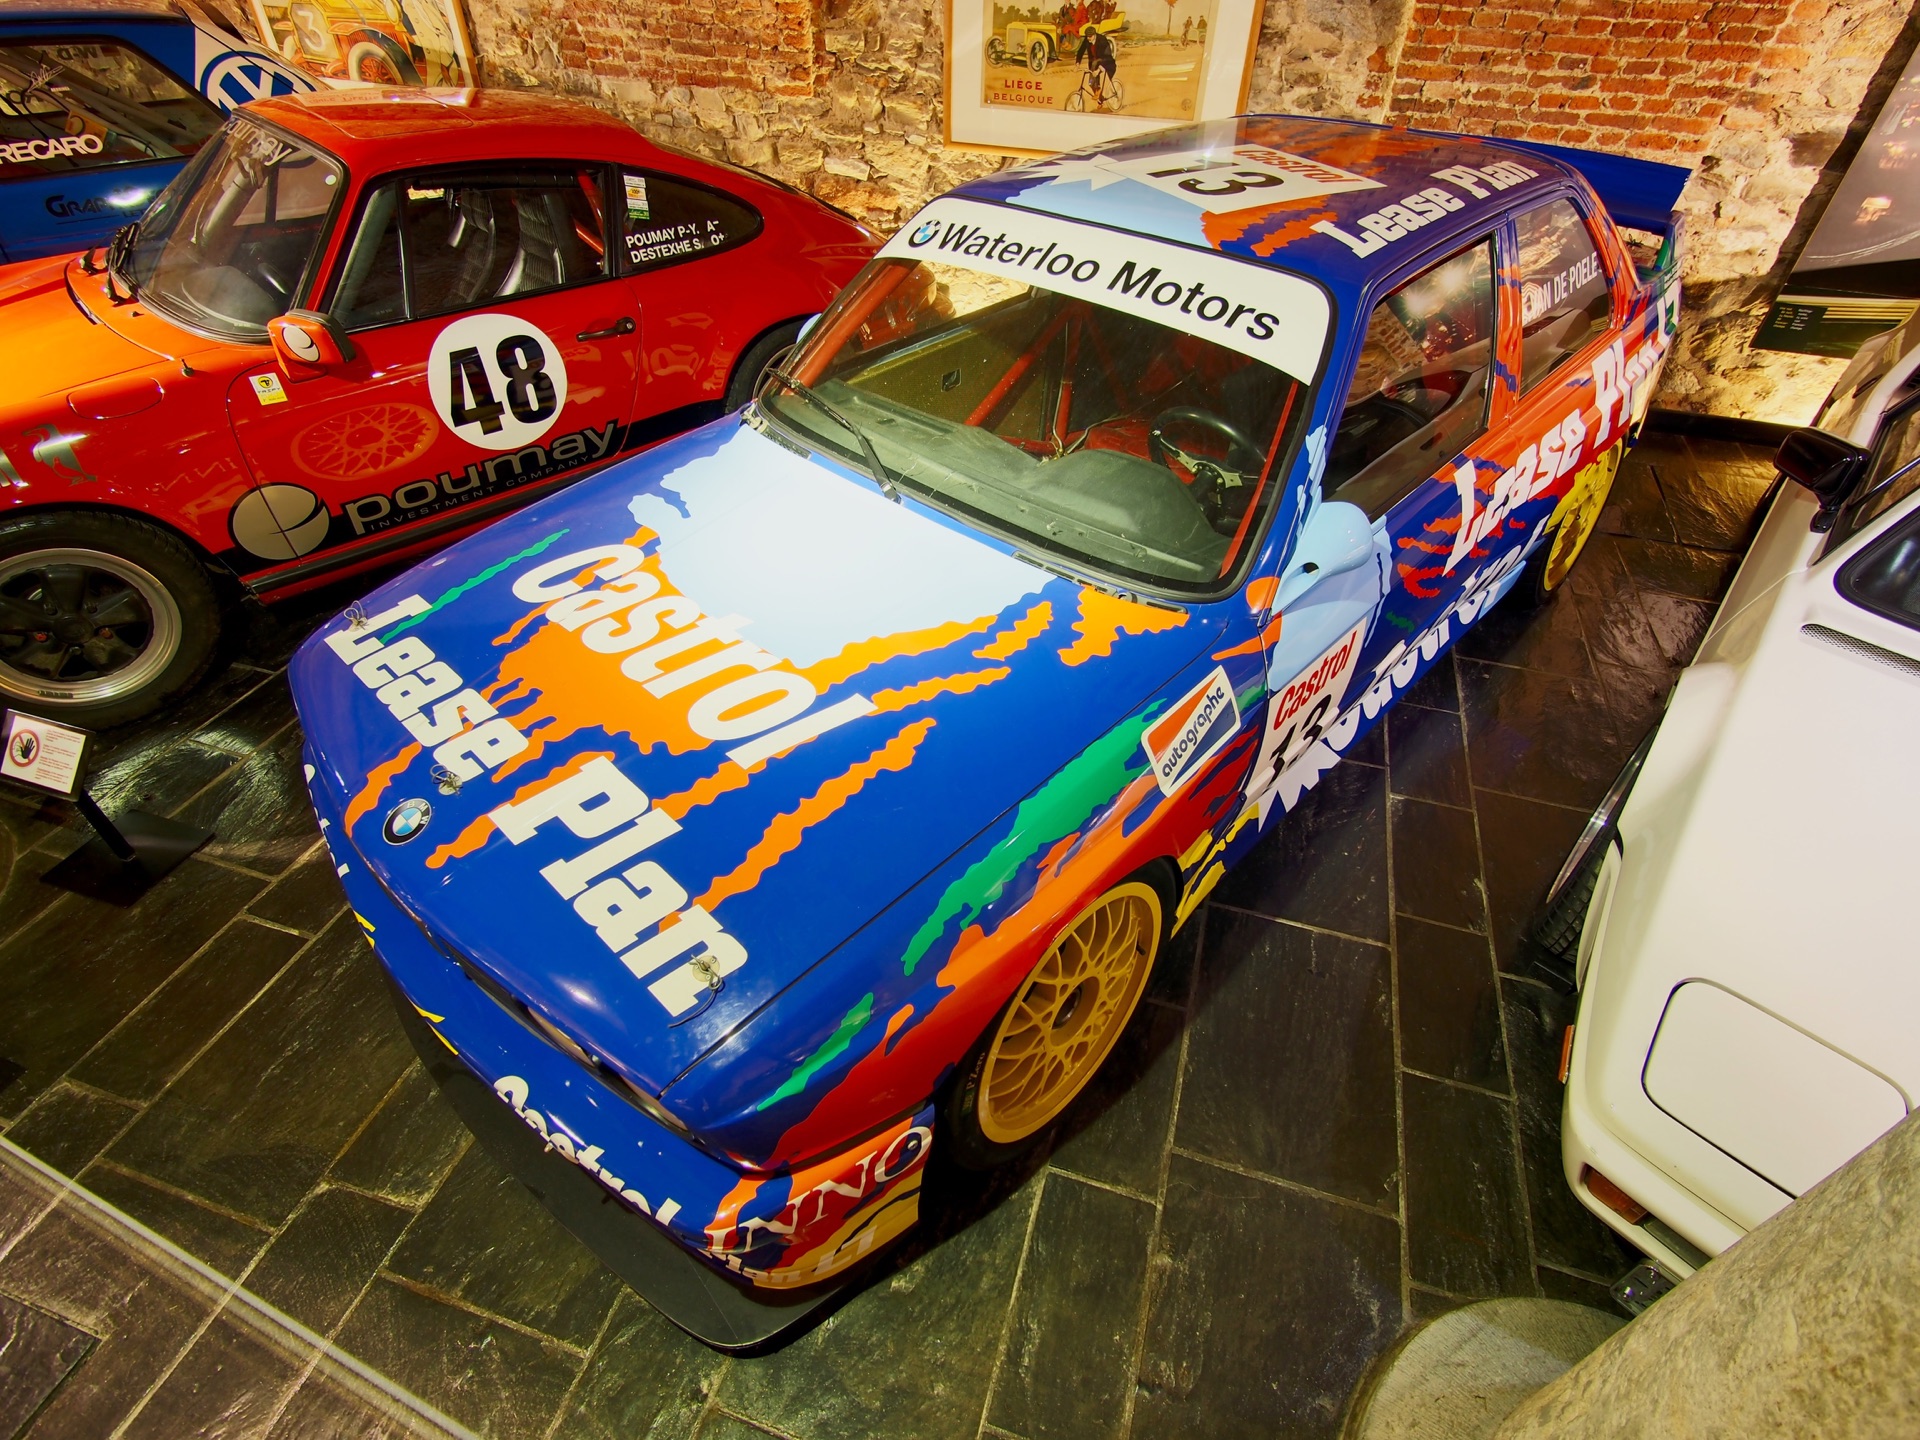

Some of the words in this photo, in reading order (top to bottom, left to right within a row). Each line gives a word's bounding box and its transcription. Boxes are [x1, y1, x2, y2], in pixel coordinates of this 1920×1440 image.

[993, 92, 1054, 105] BELGIQUE
[0, 134, 103, 164] RECARO
[1233, 150, 1363, 184] Castrol
[625, 227, 675, 248] POUMAY
[630, 240, 692, 263] DESTEXHE
[1310, 186, 1465, 259] Lease
[1431, 159, 1540, 199] Plan
[937, 222, 1100, 284] Waterloo
[1106, 261, 1281, 341] Motors
[1554, 273, 1568, 304] DE
[1569, 251, 1598, 294] POELE
[448, 334, 558, 436] 48
[345, 423, 614, 535] poumay
[370, 486, 495, 531] INVESTMENT
[506, 455, 590, 487] COMPANY
[1443, 409, 1587, 576] Lease
[1592, 338, 1660, 449] Plan
[512, 543, 878, 769] Castrol
[1273, 630, 1357, 731] Castrol
[1161, 686, 1225, 778] autographe
[324, 594, 528, 783] Lease
[488, 755, 748, 1017] Plan
[407, 801, 430, 824] BMW
